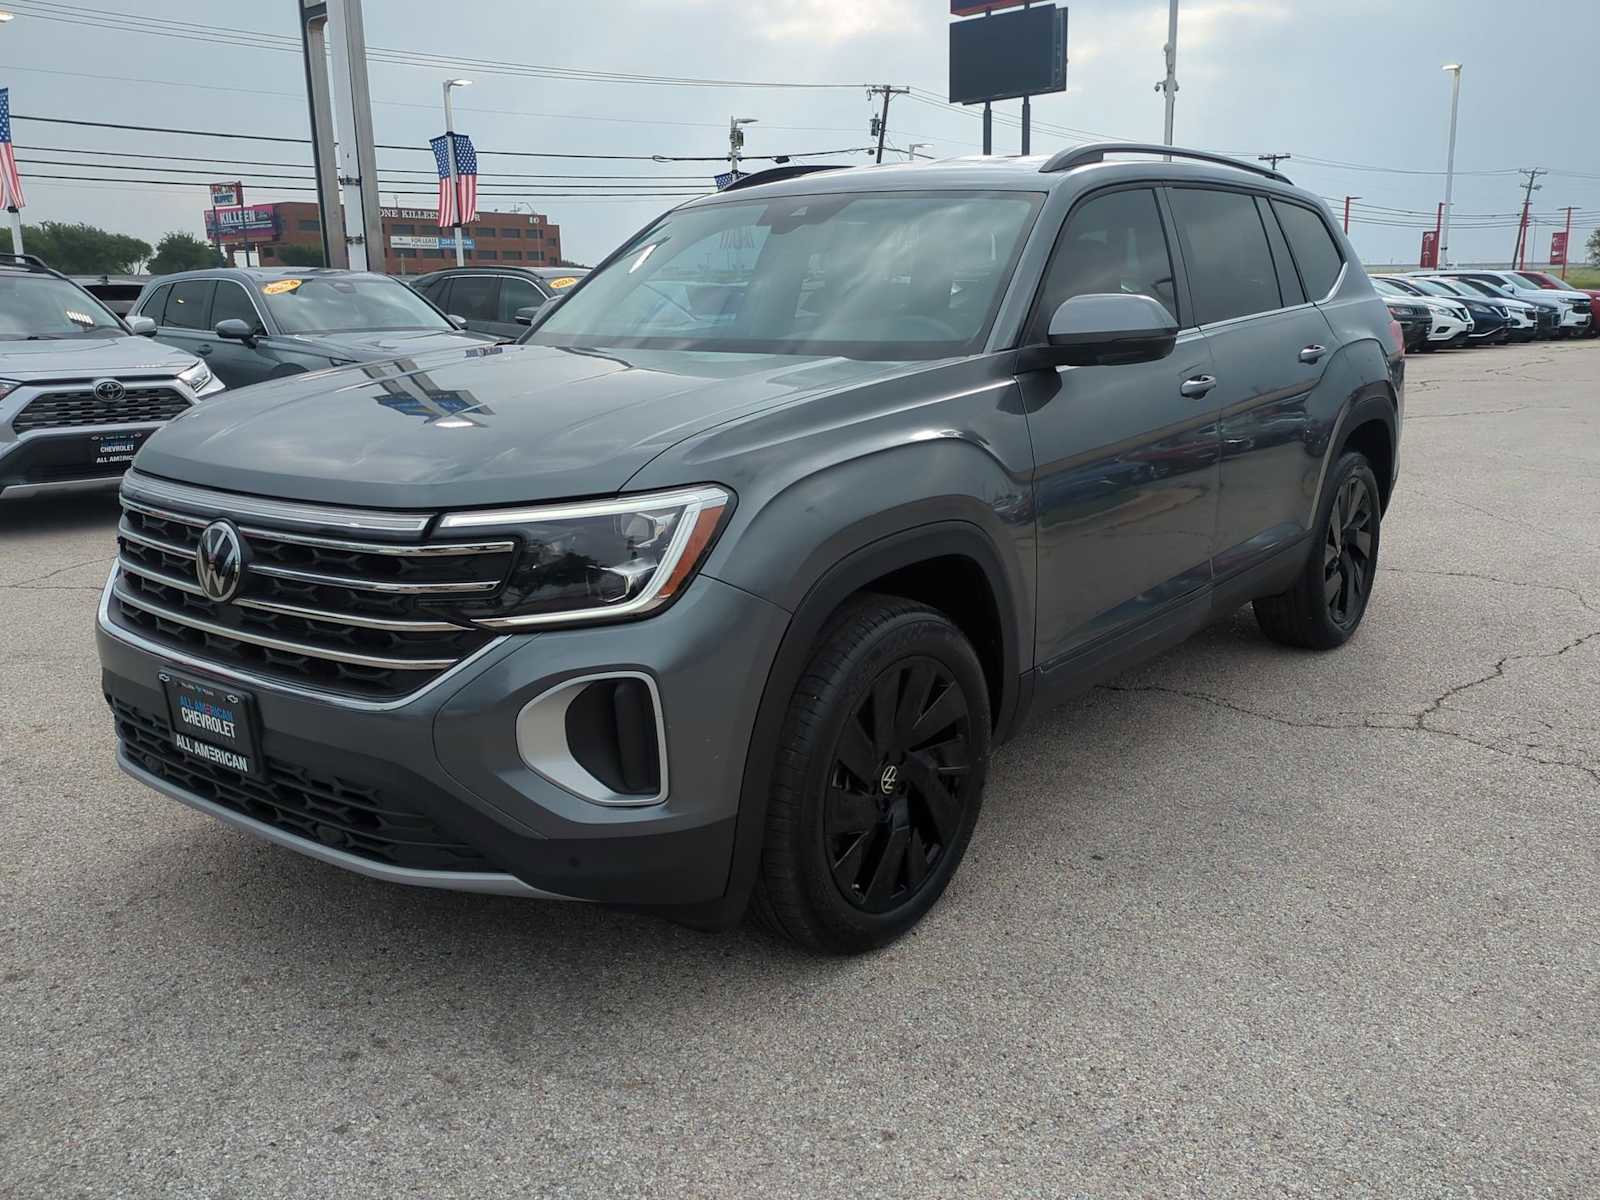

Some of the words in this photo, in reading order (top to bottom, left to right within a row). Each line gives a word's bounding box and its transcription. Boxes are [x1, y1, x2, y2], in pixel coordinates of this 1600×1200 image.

[221, 210, 256, 225] KILLEEN
[380, 208, 399, 218] ONE
[100, 444, 134, 453] CHEVROLET
[96, 456, 108, 464] ALL
[181, 707, 236, 738] CHEVROLET
[176, 734, 193, 753] ALL
[194, 741, 249, 772] AMERICAN
